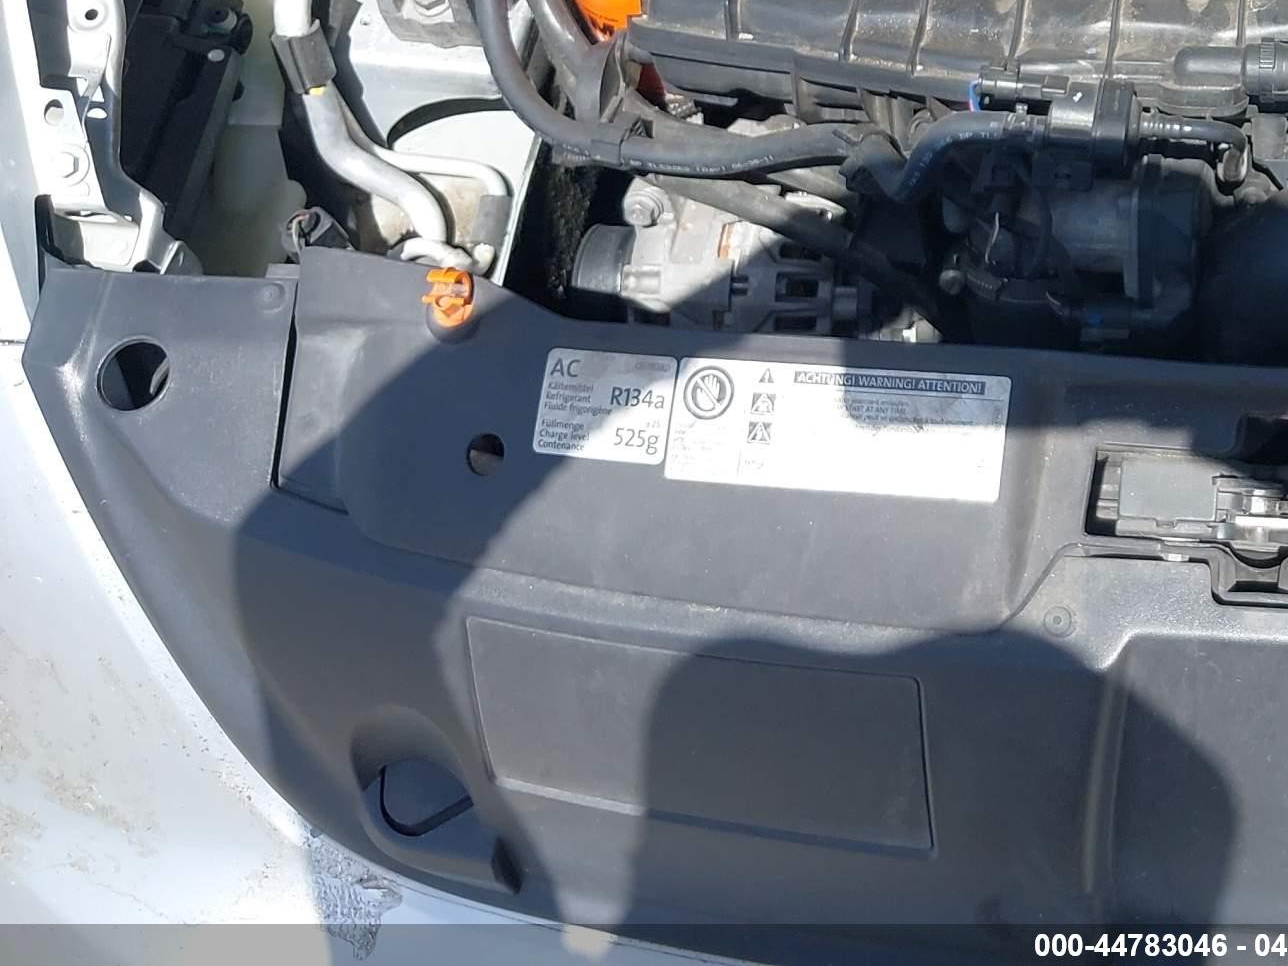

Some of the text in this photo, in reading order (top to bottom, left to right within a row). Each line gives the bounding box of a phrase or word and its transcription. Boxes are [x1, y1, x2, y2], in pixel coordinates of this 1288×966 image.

[550, 357, 581, 378] AC
[796, 371, 983, 394] ACHTUNG! WARNING! ATTENTION!
[546, 392, 591, 404] Refrigerant
[610, 387, 665, 410] R134a
[541, 419, 585, 432] Füllmenge
[539, 429, 590, 442] Charge level
[614, 427, 659, 456] 525g
[538, 440, 585, 452] Contenance
